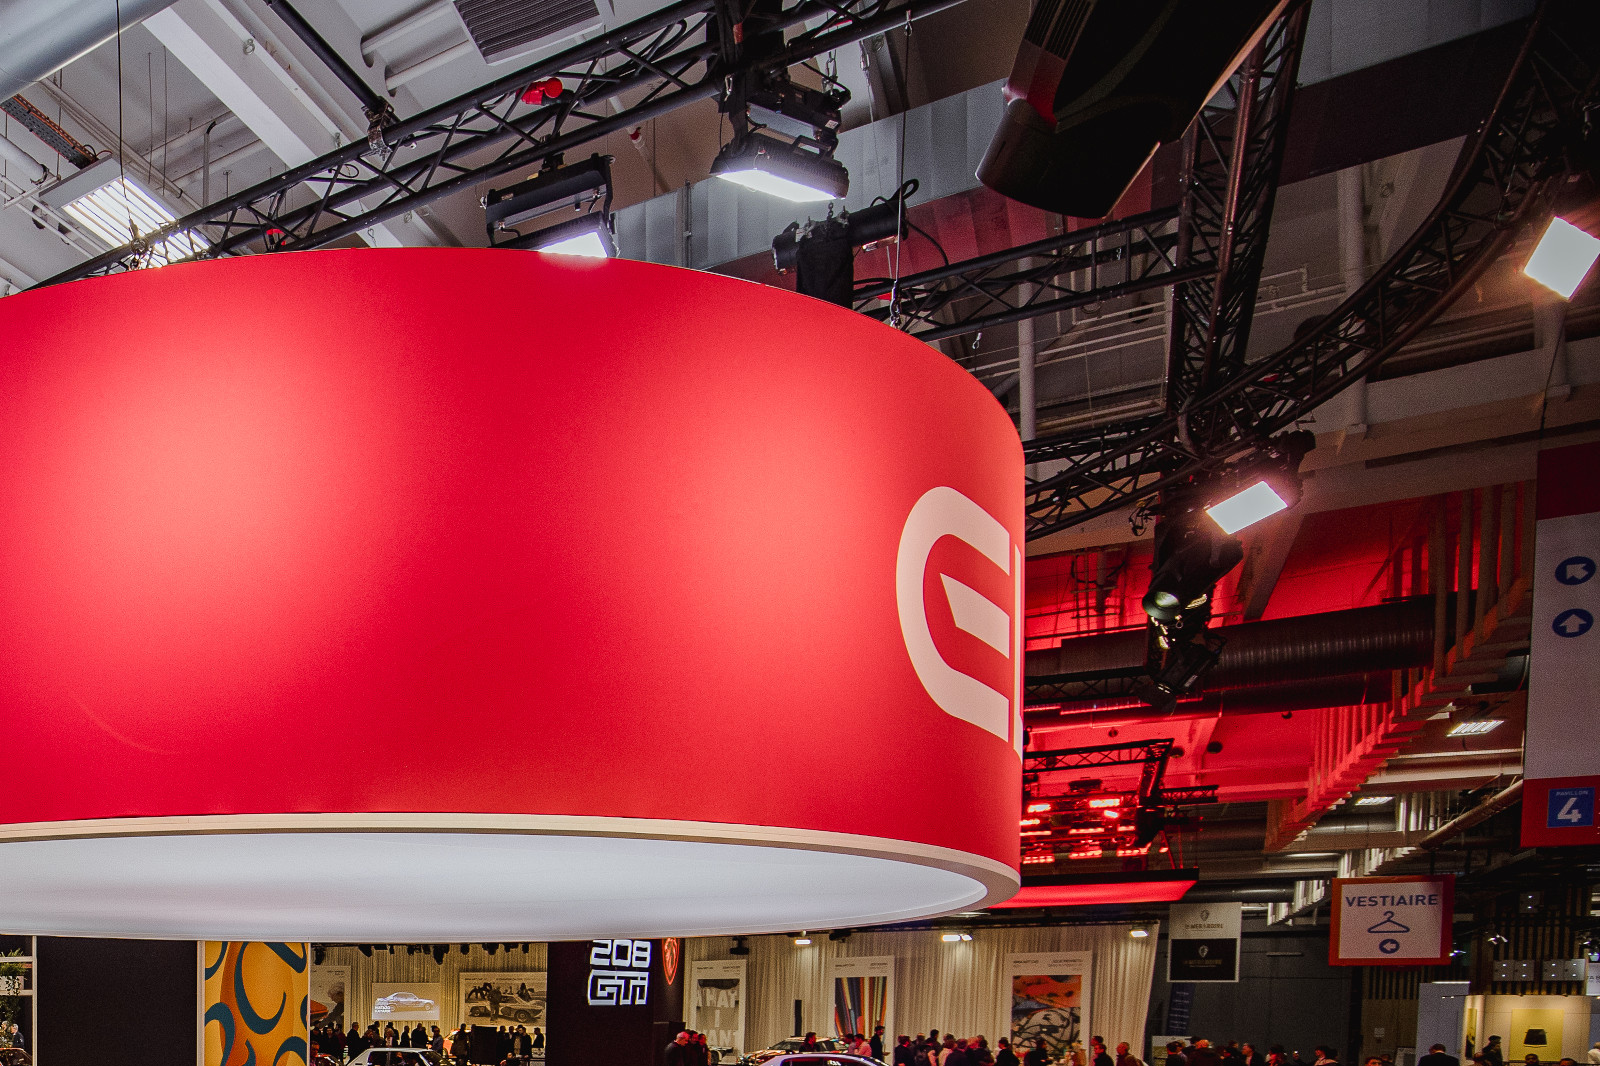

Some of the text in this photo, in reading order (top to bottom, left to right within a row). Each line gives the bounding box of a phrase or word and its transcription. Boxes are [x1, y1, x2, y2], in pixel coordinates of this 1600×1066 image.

[1557, 797, 1582, 822] 4
[1345, 894, 1439, 908] VESTIAIRE
[590, 939, 652, 967] 208
